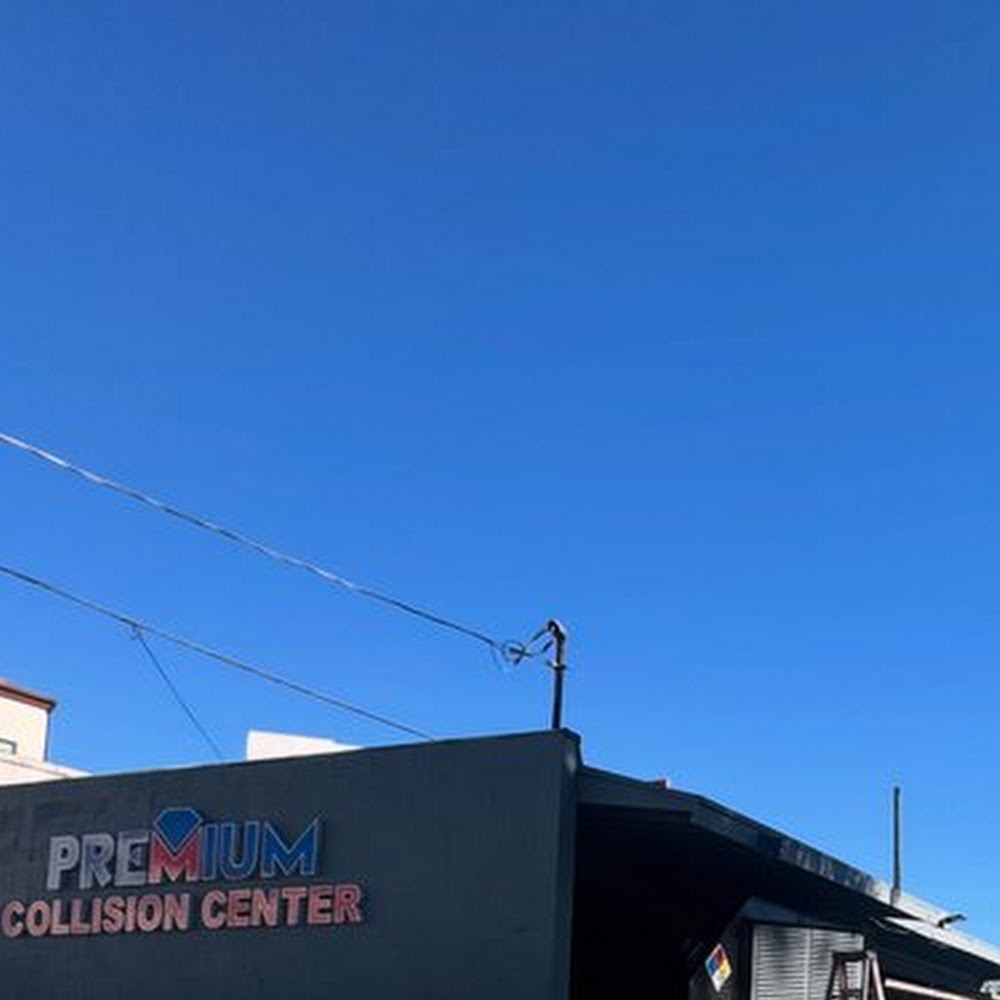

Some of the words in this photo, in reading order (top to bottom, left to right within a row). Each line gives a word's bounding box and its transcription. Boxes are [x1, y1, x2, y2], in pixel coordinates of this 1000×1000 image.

[46, 807, 322, 890] PREMIUM
[1, 892, 191, 938] COLLISION
[201, 883, 364, 931] CENTER
